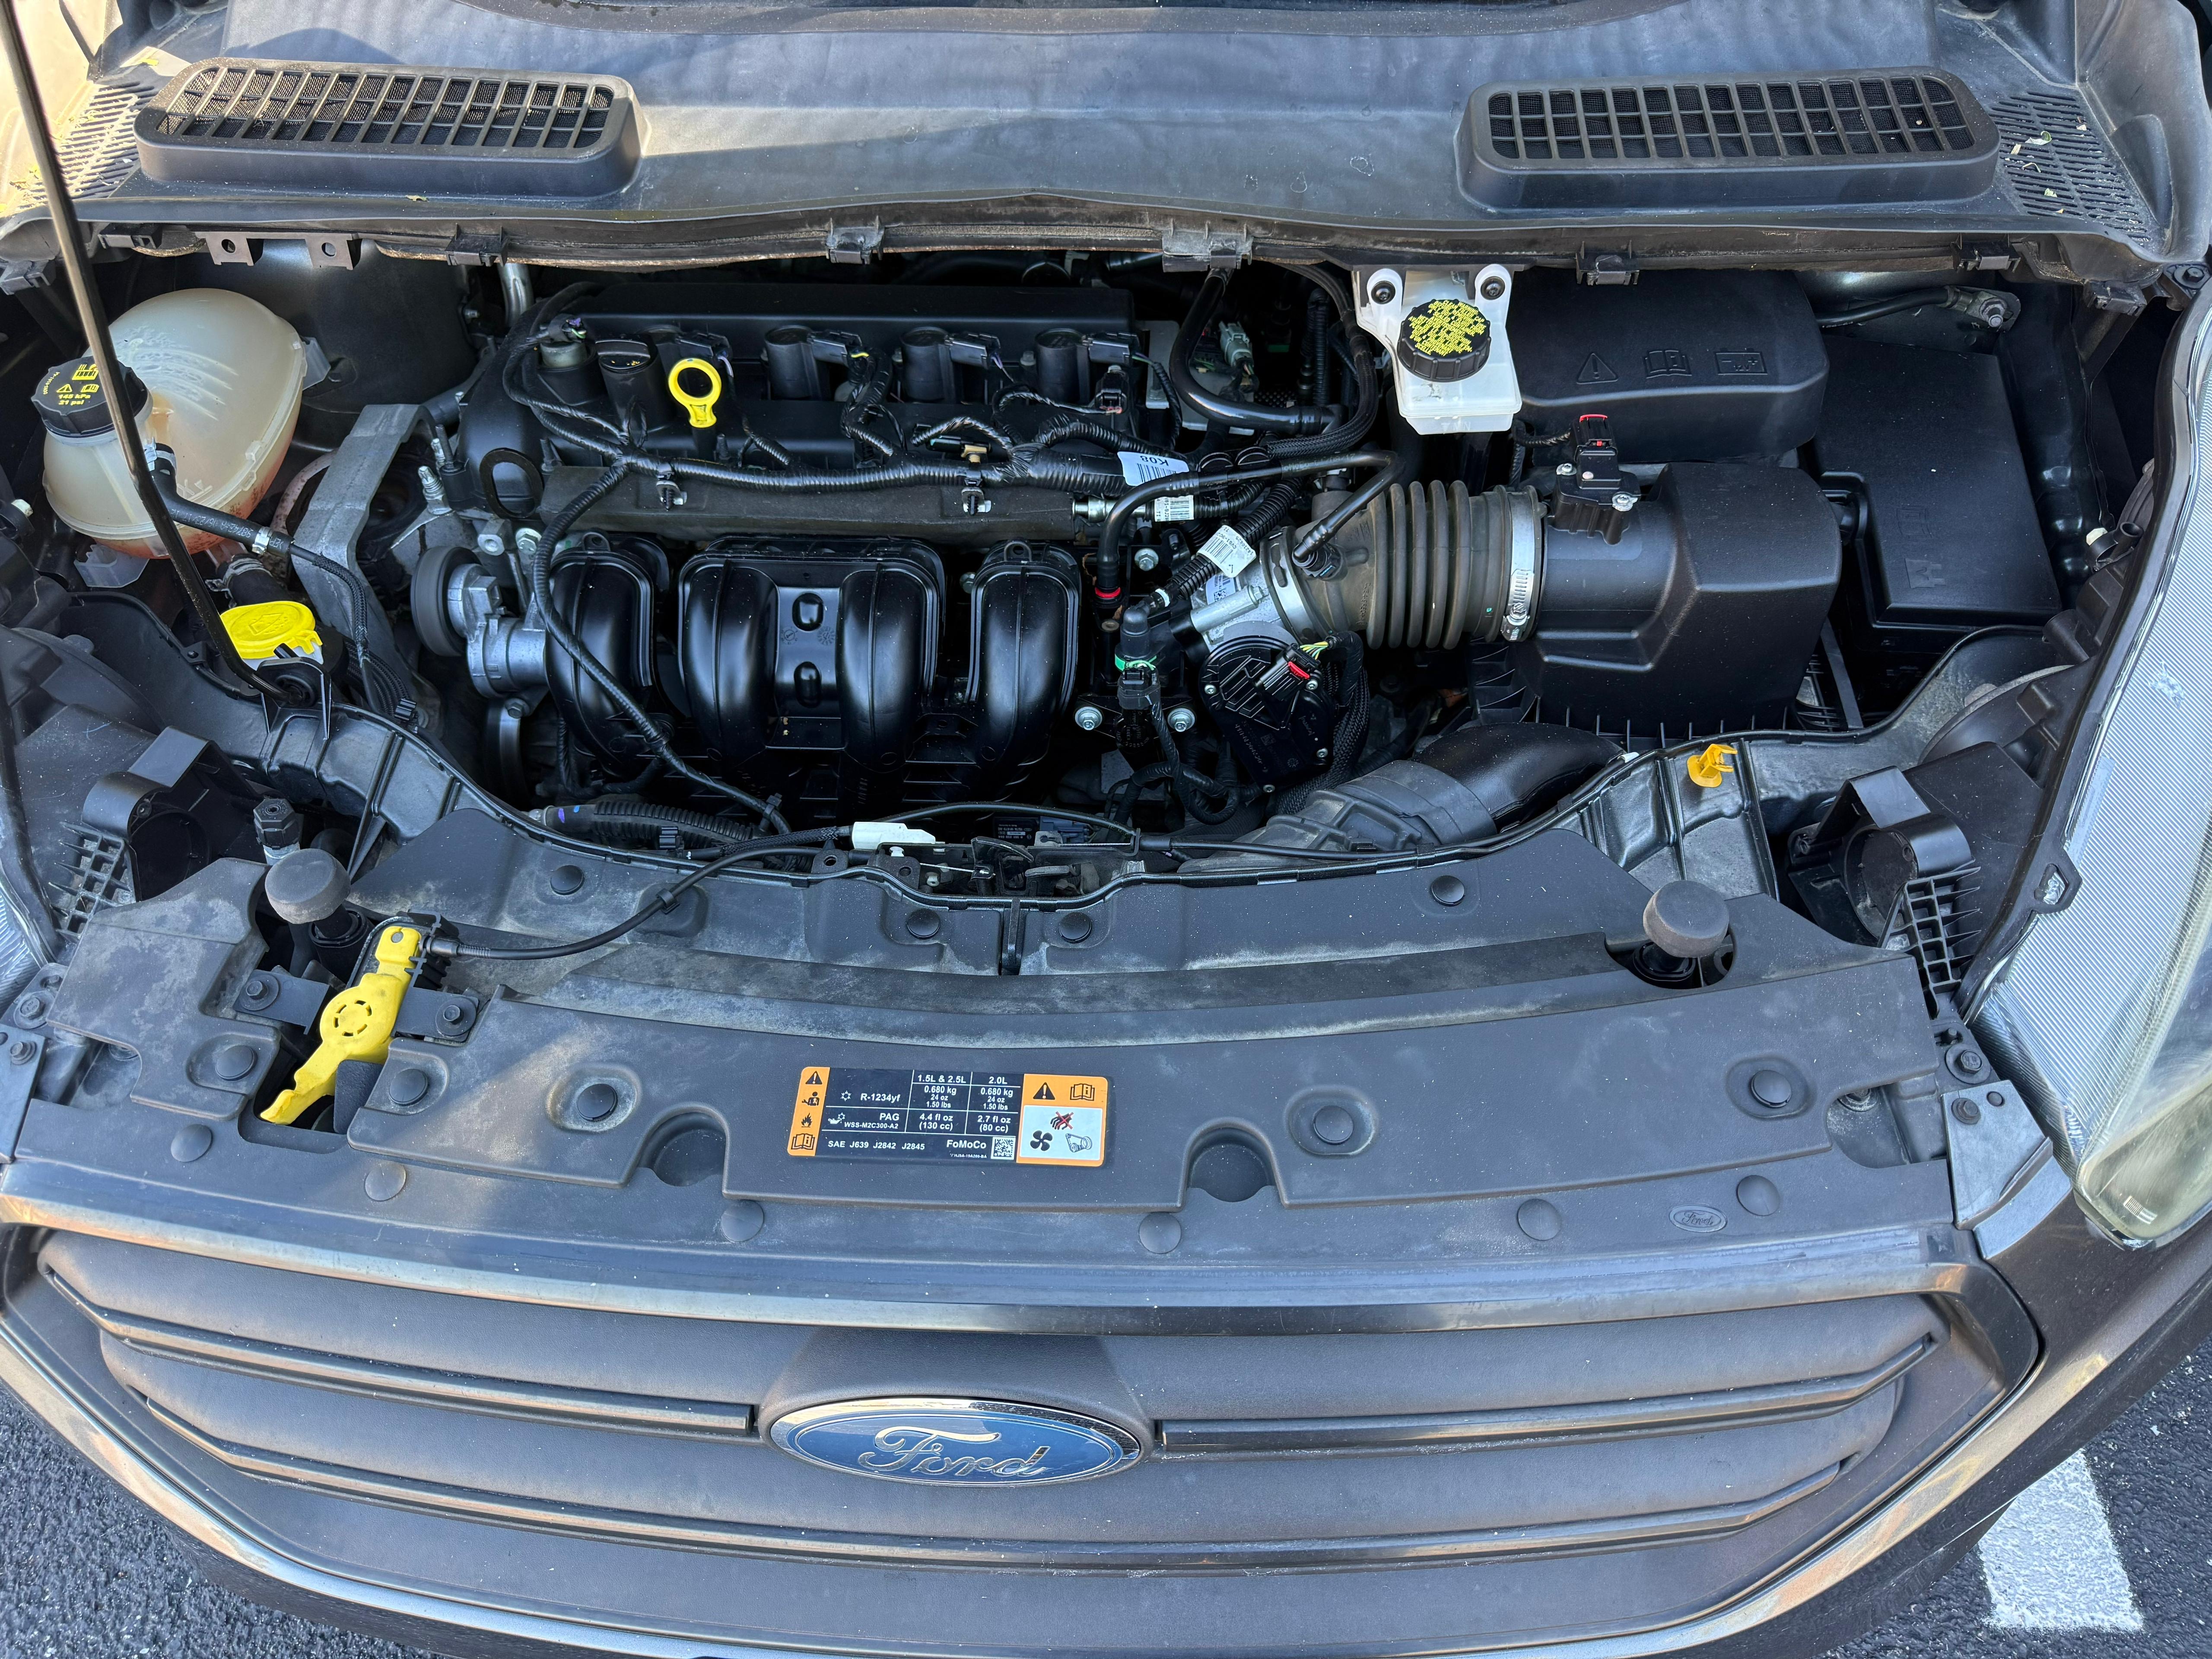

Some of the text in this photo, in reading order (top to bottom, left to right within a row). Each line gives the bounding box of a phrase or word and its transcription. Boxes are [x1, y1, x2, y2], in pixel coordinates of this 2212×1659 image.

[1140, 455, 1169, 466] K08
[988, 1076, 1007, 1084] 2.0L
[924, 1085, 957, 1095] 0.680 kg
[980, 1087, 1013, 1097] 0.680 kg
[861, 1093, 901, 1103] R-1234yf
[919, 1122, 953, 1131] (130 cc)
[979, 1123, 1008, 1134] (80 cc)
[947, 1139, 986, 1149] FoMoCo
[1681, 1211, 1713, 1225] Ford
[858, 1425, 1051, 1476] Ford
